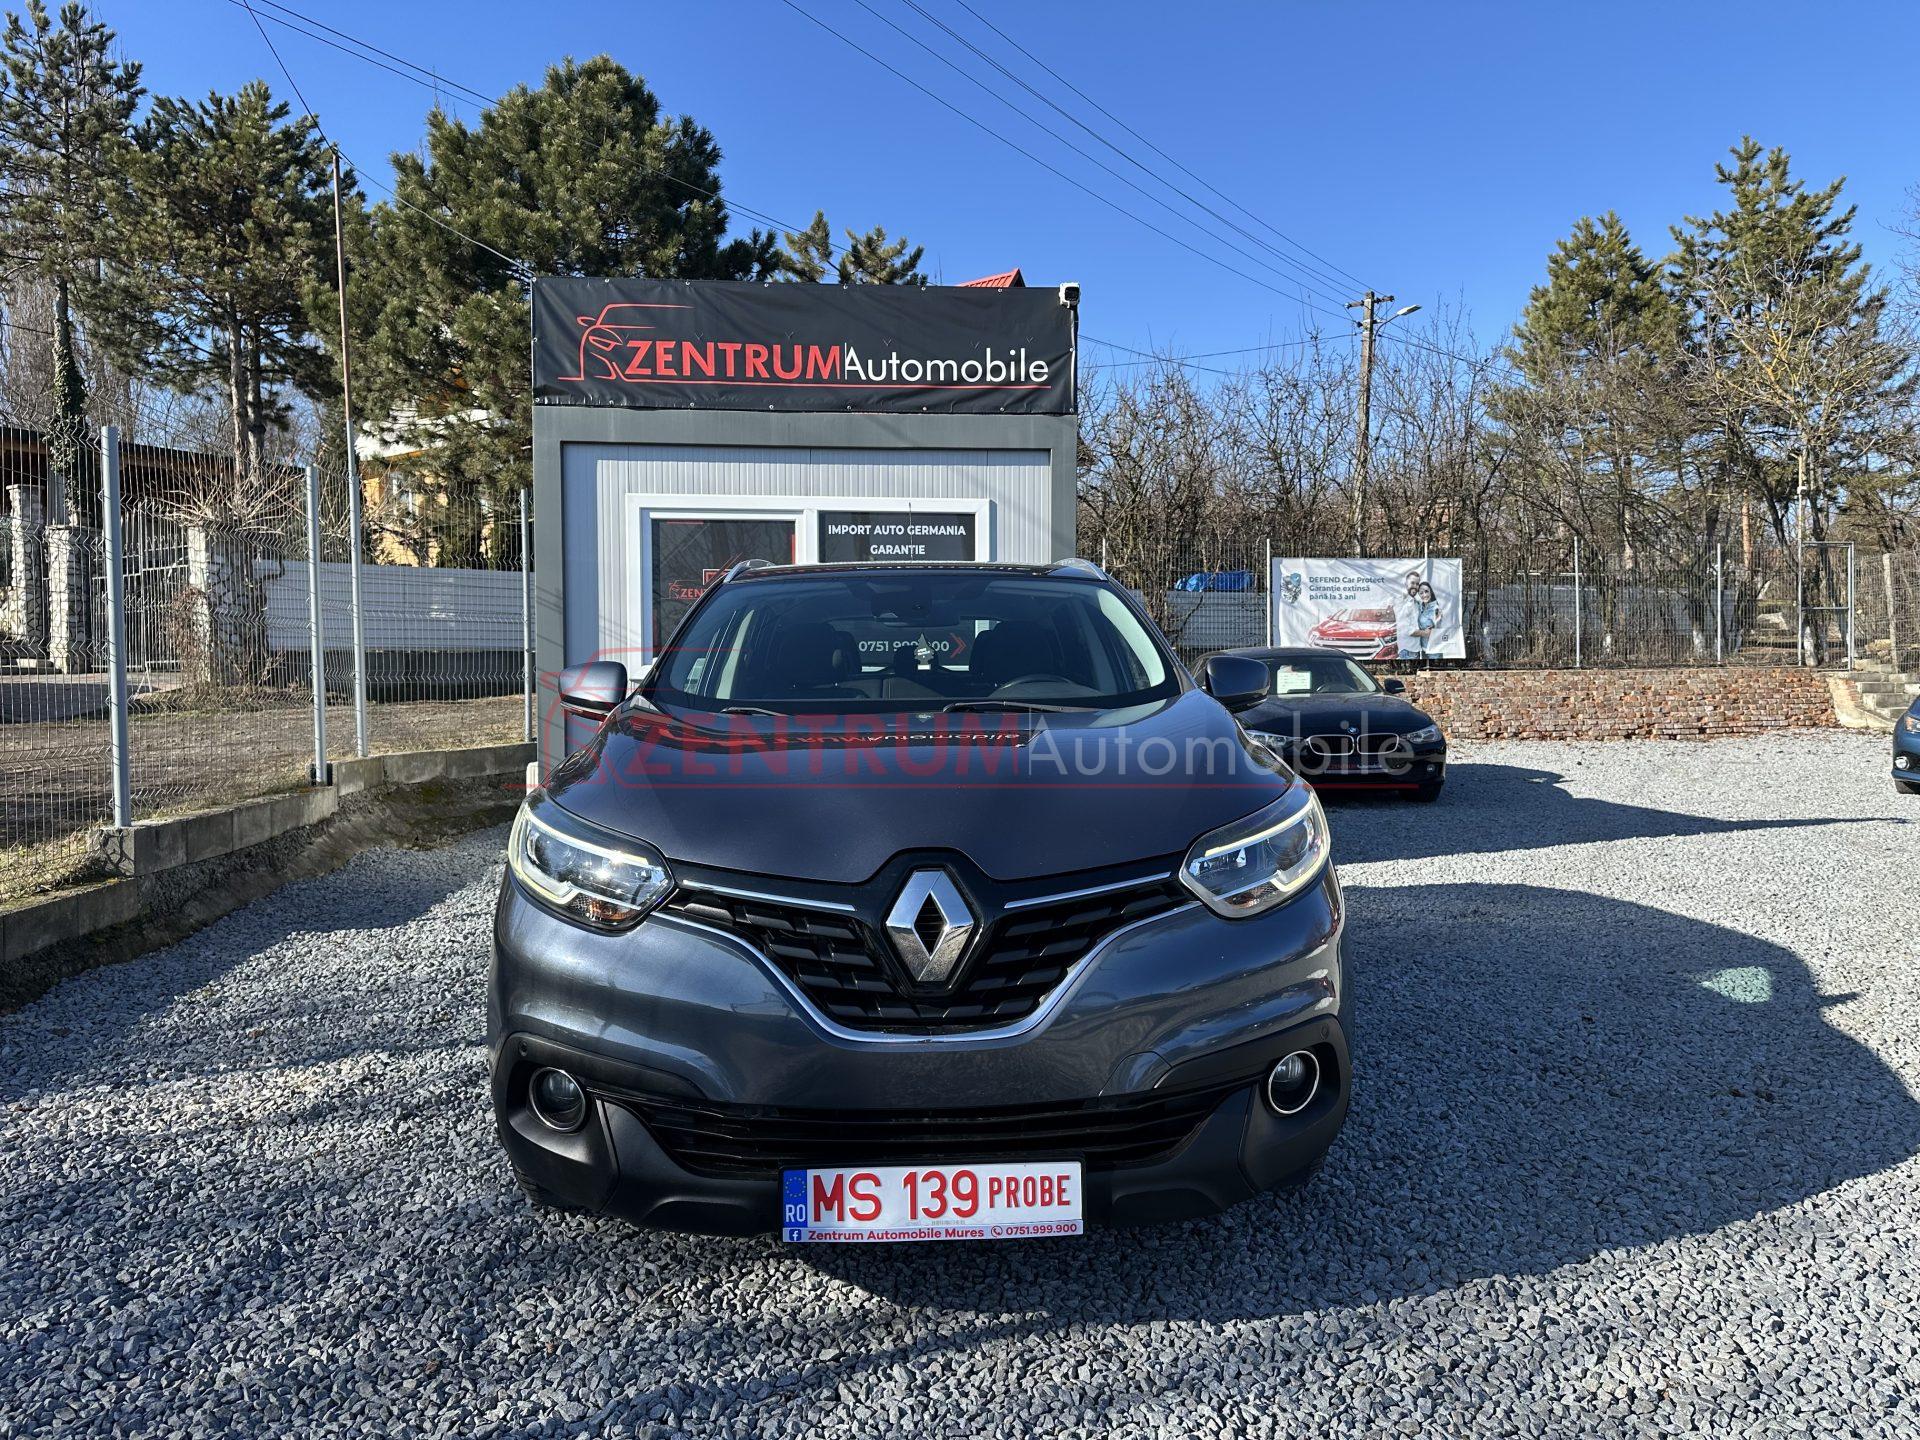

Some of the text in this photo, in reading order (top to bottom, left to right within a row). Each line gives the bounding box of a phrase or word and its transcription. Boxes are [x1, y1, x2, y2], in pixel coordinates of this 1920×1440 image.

[625, 340, 1049, 383] ZENTRUM Automobile
[828, 525, 967, 536] IMPORT AUTO GERMANIA
[681, 588, 708, 599] ZEN
[858, 640, 889, 652] 0751
[925, 640, 950, 652] 00
[812, 1169, 1071, 1222] MS 139 PROBE
[785, 1203, 806, 1223] RO
[808, 1223, 1077, 1241] Zentrum Automobile Mures 0751.999.900
